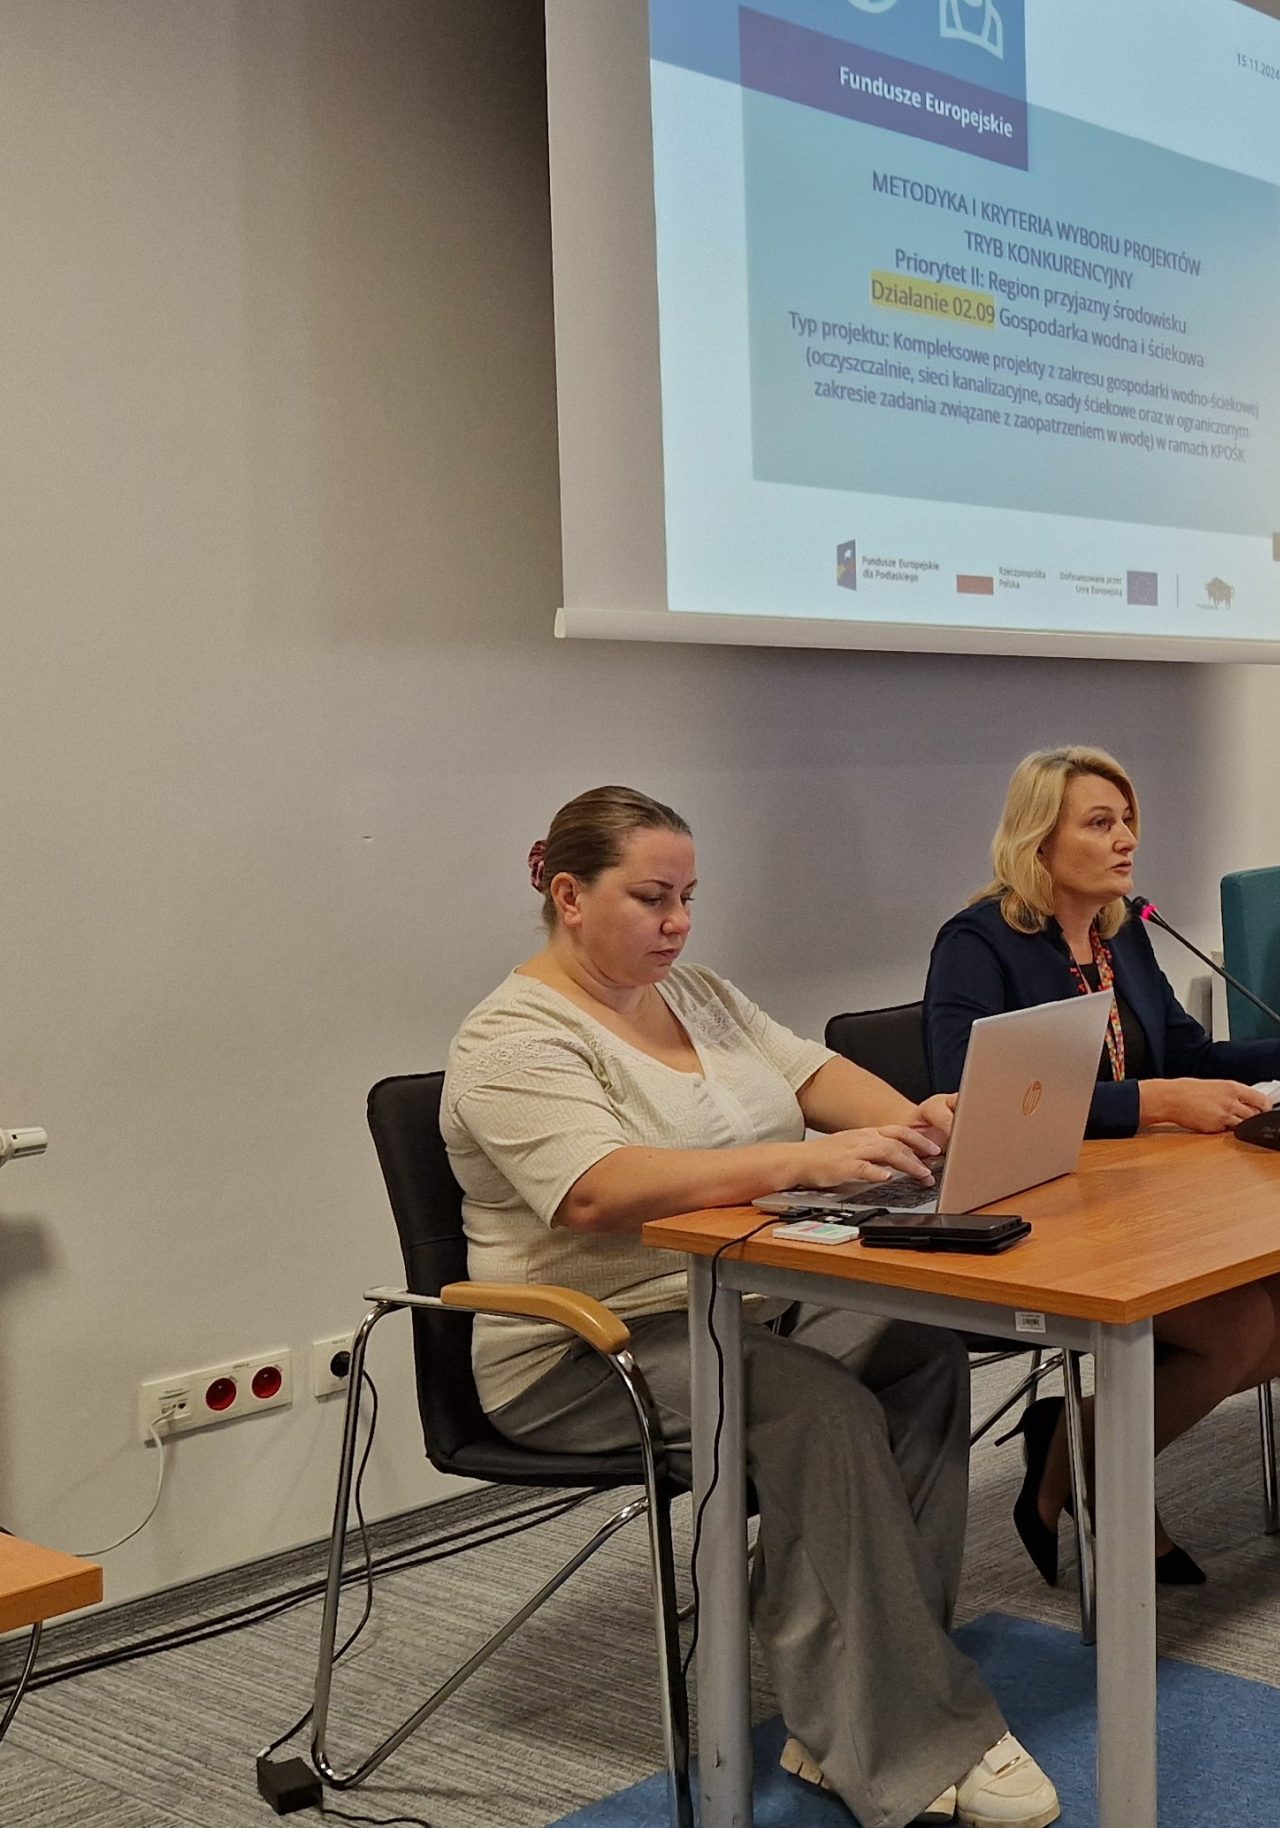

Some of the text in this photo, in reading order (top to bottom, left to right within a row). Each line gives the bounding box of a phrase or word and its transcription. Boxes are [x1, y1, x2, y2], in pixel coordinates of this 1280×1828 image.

[839, 66, 1013, 138] Fundusze Europejskie
[1237, 53, 1280, 80] 15.11.2024
[872, 171, 1201, 277] METODYKA I KRYTERIA WYBORU PROJEKTÓW
[964, 230, 1133, 290] TRYB KONKURENCYJNY
[871, 279, 1204, 368] Działanie 02.09 Gospodarka wodna i ściekowa
[895, 248, 1187, 334] Priorytet II: Region przyjazny środowisku
[788, 311, 1260, 420] Typ projektu: Kompleksowe projekty z zakresu gospodarki wodno-ściekowej
[806, 347, 1250, 441] (oczyszczalnie, sieci kanalizacyjne, osady ściekowe oraz w ograniczonym
[814, 380, 1246, 463] zakresie zadania związane z zaopatrzeniem w wodę) w ramach KPOŚK
[862, 556, 940, 571] Fundusze Europejskie
[862, 570, 875, 579] dla
